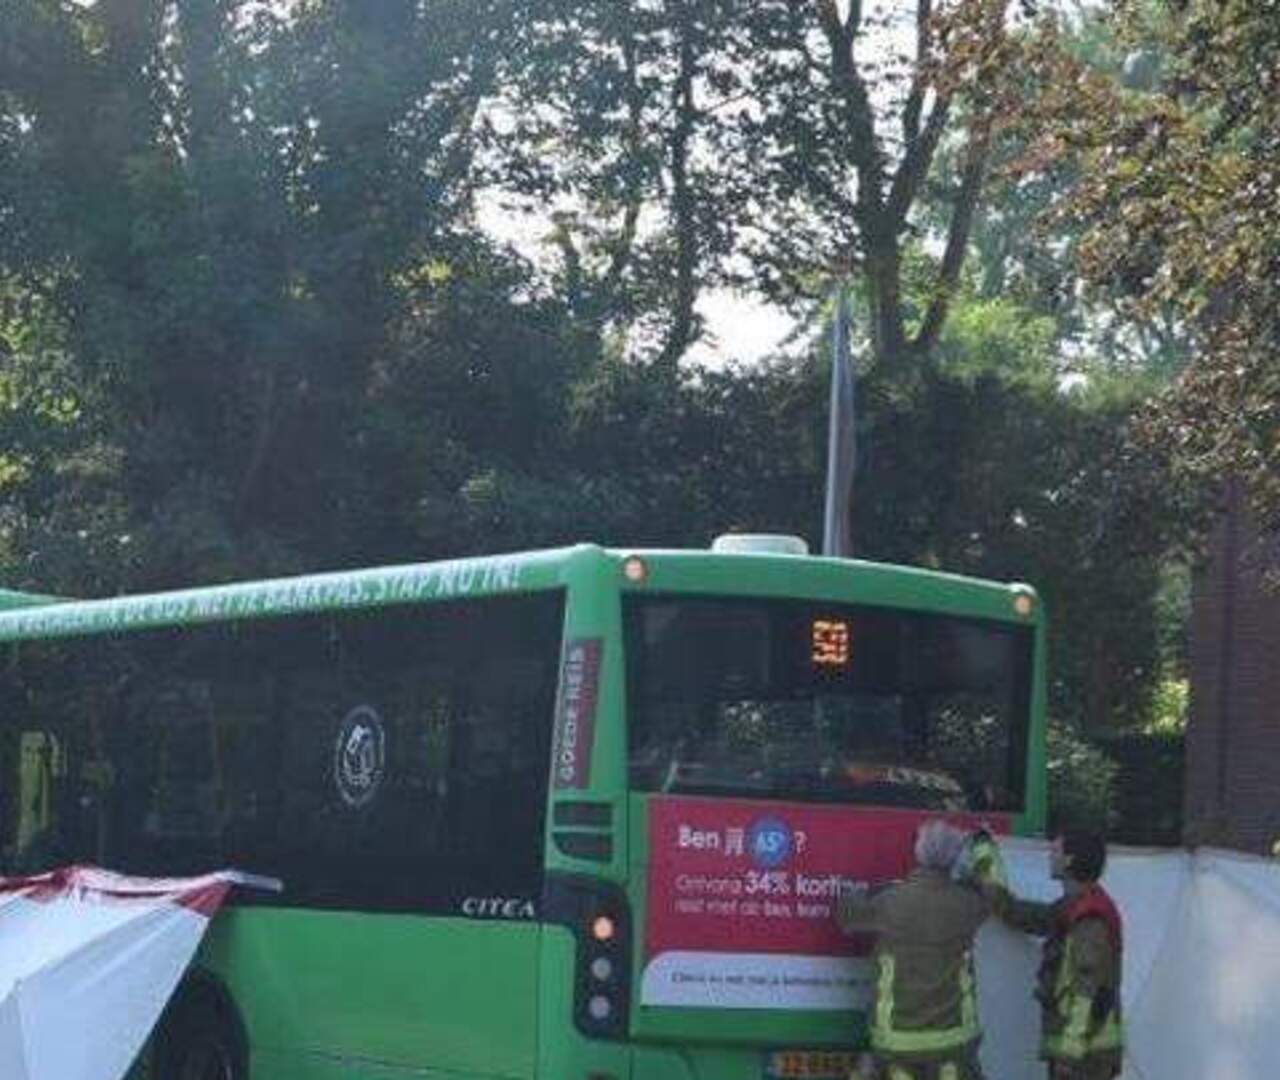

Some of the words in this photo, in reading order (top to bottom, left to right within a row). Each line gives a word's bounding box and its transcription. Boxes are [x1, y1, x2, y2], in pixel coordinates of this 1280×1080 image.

[437, 564, 472, 594] NU
[679, 825, 719, 849] Ben
[746, 871, 790, 894] 34%
[462, 897, 535, 917] CITEA
